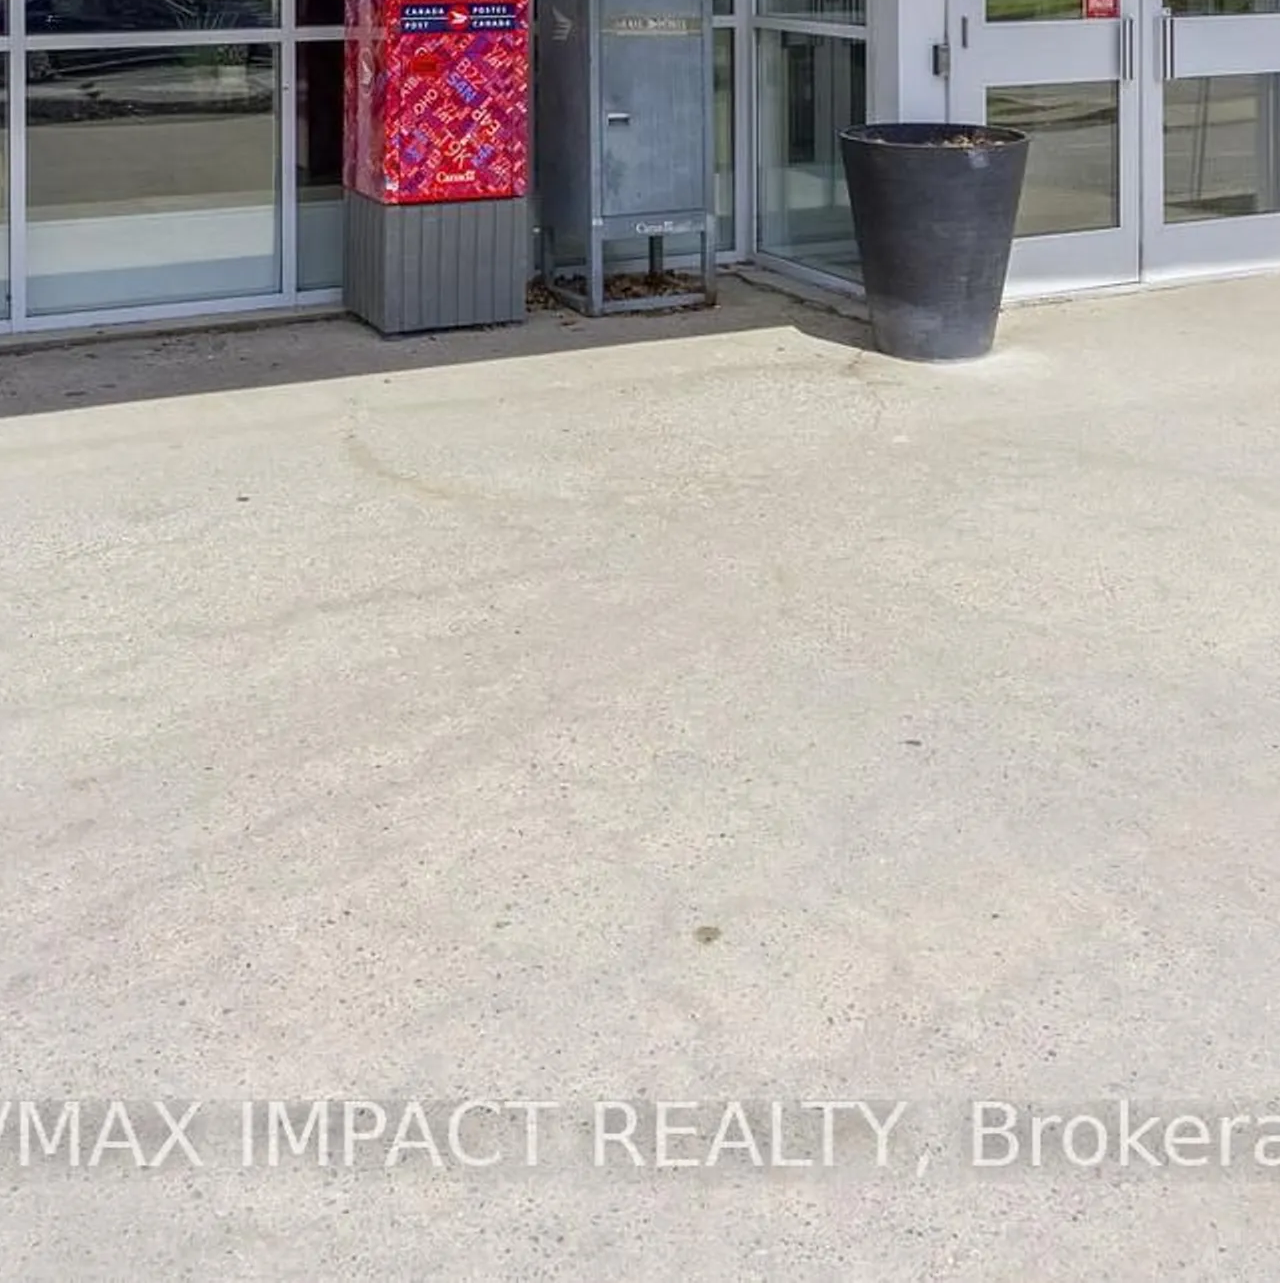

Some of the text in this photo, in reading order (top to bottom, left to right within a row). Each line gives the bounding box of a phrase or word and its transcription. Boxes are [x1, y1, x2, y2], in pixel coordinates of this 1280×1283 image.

[404, 6, 445, 16] CANADA
[471, 5, 508, 15] POSTES
[403, 21, 429, 30] POST
[471, 20, 512, 29] CANADA
